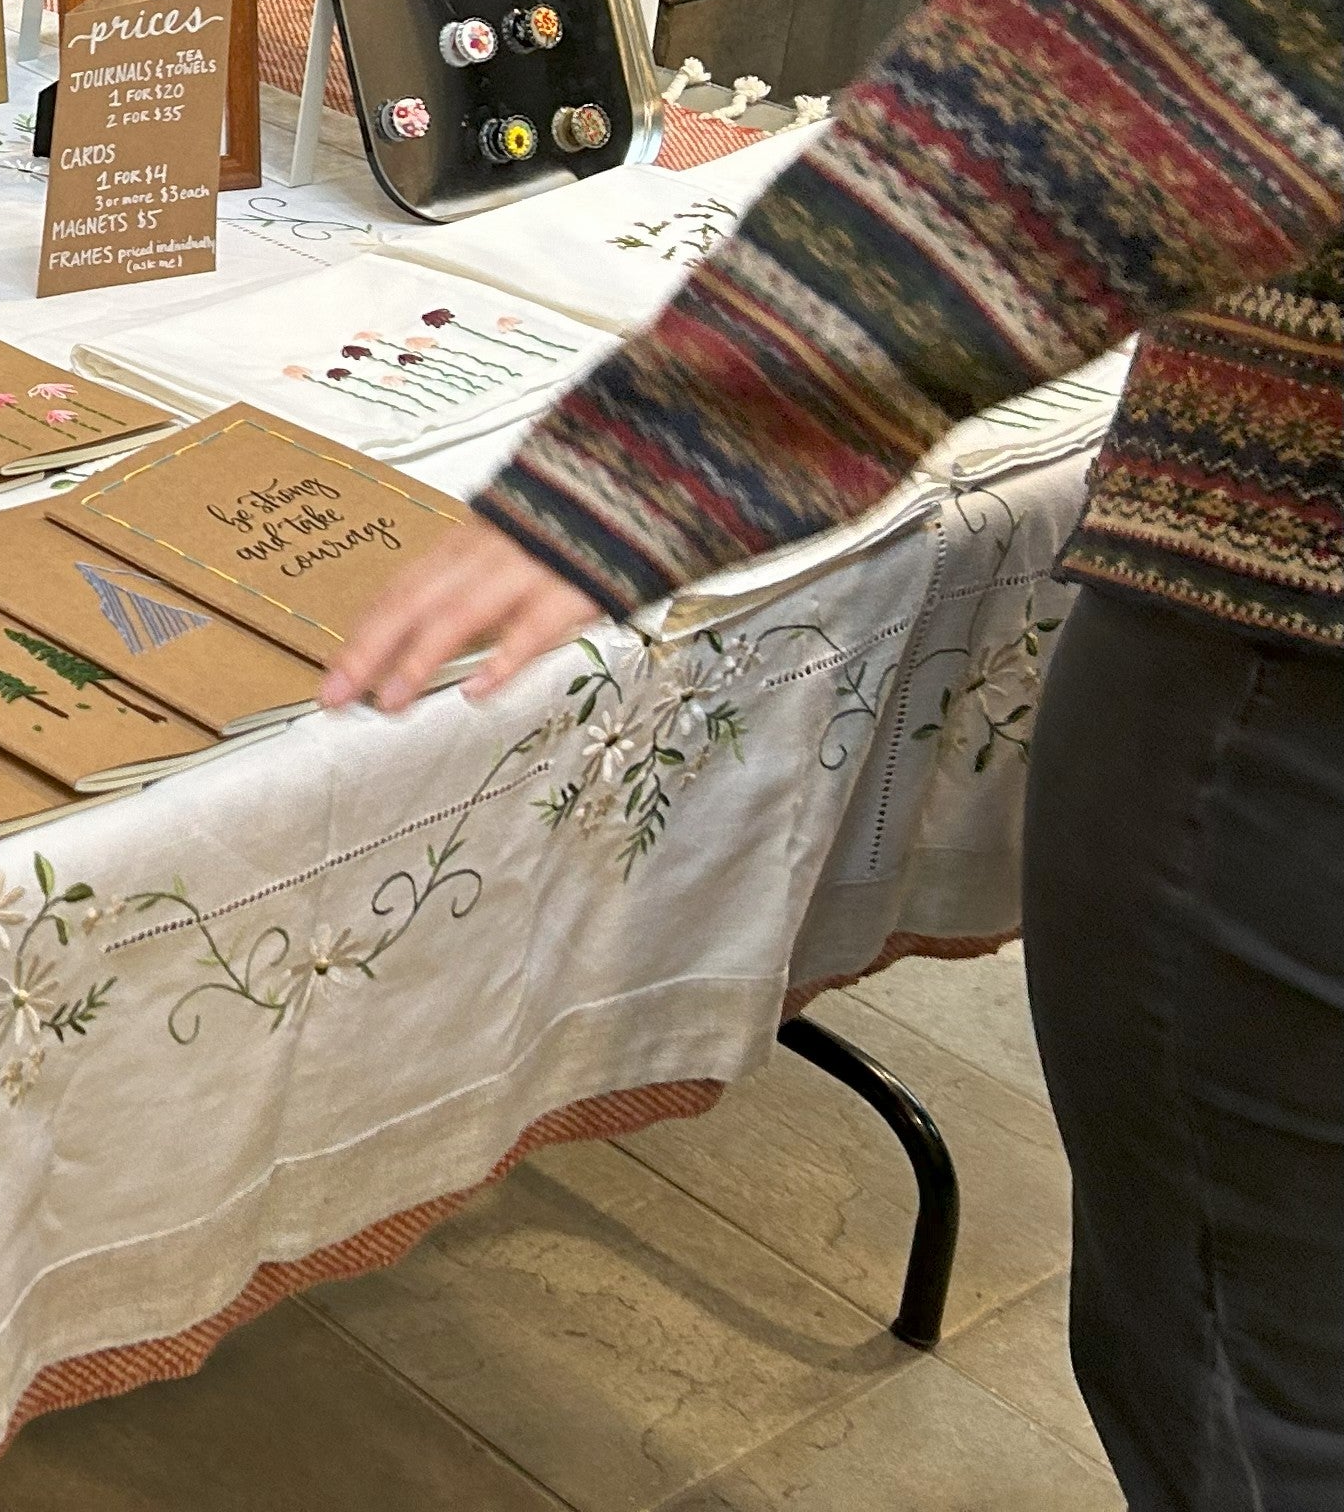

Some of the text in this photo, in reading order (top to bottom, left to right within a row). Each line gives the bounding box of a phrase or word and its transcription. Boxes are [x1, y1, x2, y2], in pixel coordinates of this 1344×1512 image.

[68, 6, 224, 55] prices
[176, 48, 204, 63] TEA
[70, 59, 217, 93] JOURNALS & TOWELS
[108, 83, 185, 107] 1 FOR $20
[106, 104, 186, 129] 2 FOR $35
[60, 143, 116, 170] CARDS
[96, 163, 168, 191] 1 FOR $4
[94, 184, 210, 211] 3 or more $3 each
[52, 208, 163, 241] MAGNETS $5
[48, 234, 215, 270] FRAMES priced individually
[126, 254, 183, 274] (ask me)
[206, 478, 342, 533] be strong
[236, 504, 345, 561] and take
[280, 515, 402, 577] courage
